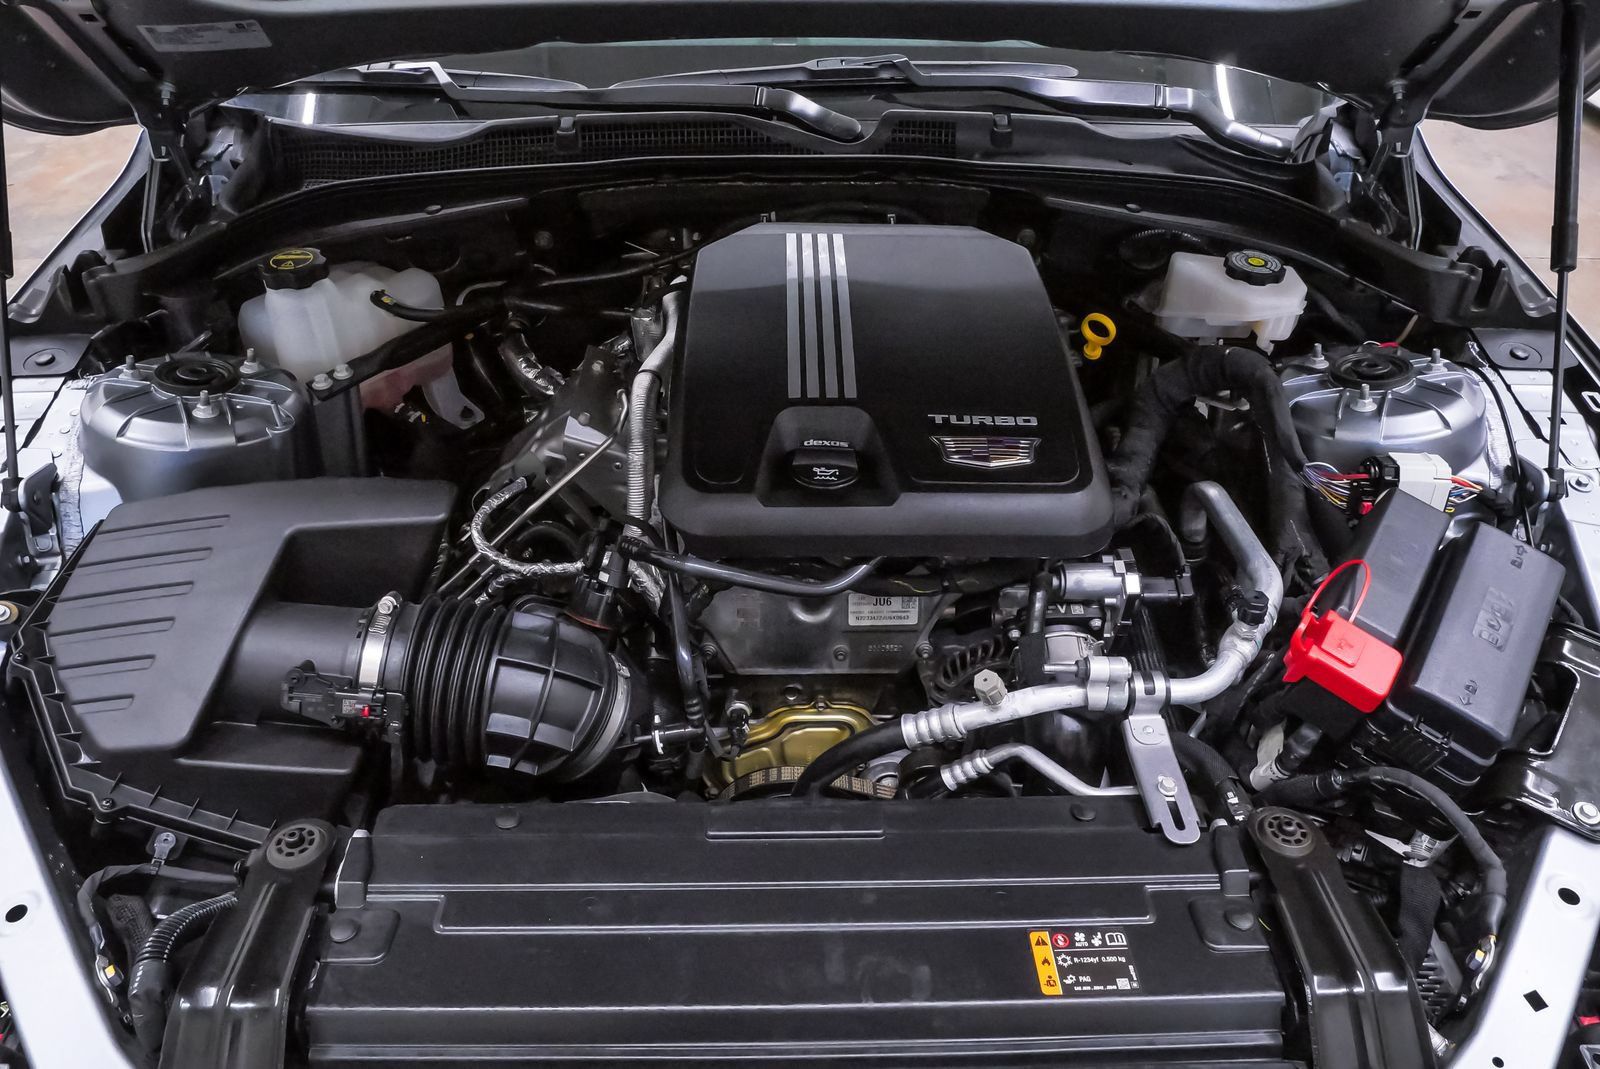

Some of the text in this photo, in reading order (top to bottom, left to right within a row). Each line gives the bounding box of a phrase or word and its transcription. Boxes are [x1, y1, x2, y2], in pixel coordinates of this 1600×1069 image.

[927, 413, 1038, 426] TURBO
[803, 438, 849, 448] dexos
[872, 598, 892, 606] JU6
